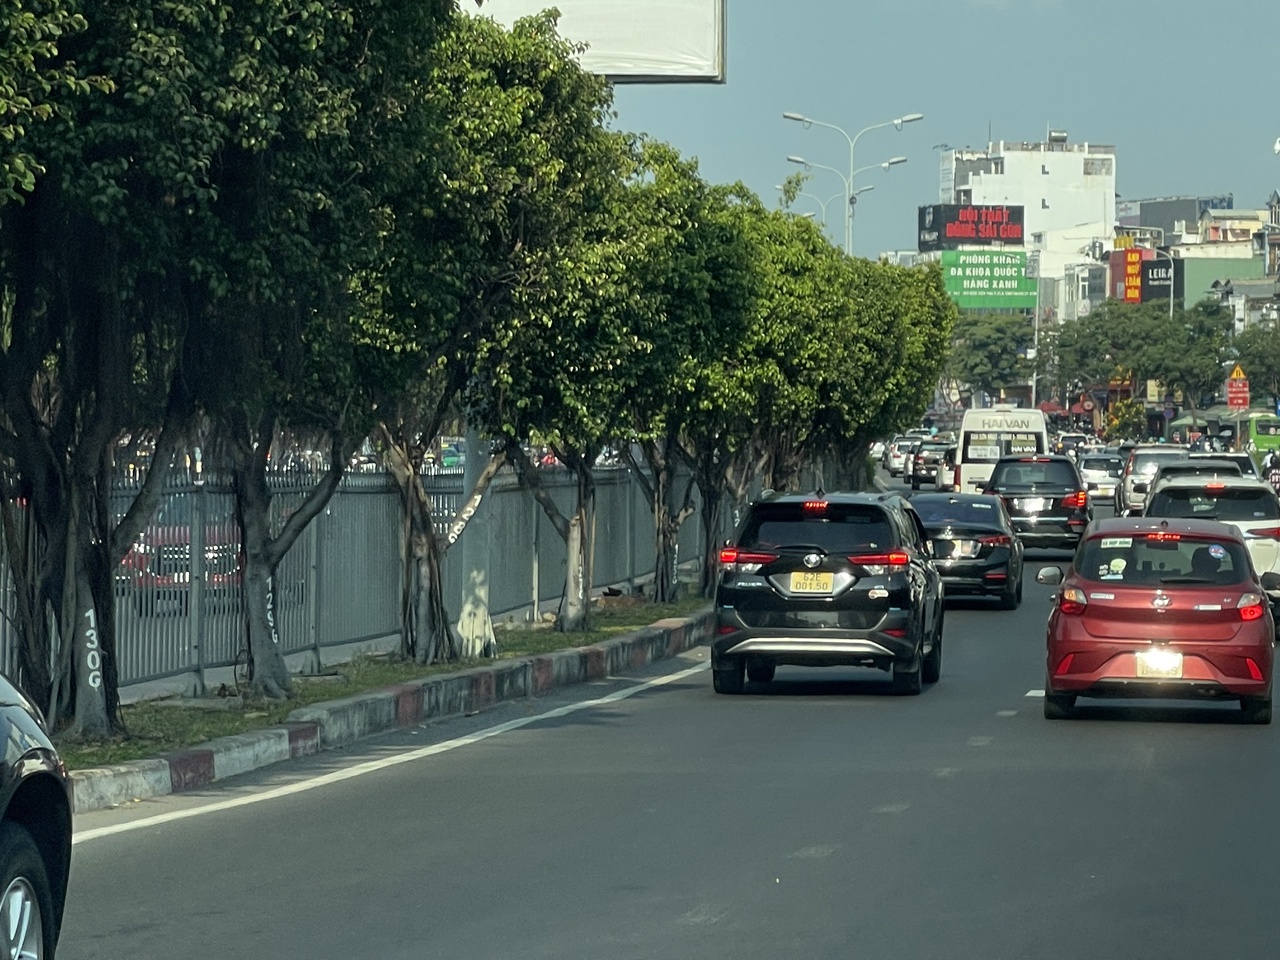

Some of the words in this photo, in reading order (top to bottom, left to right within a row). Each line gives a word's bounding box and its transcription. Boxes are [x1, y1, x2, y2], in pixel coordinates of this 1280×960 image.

[966, 267, 991, 277] KHOA
[992, 280, 1018, 289] XANH
[803, 573, 822, 582] 62E
[795, 582, 829, 591] 001.50
[85, 608, 101, 688] 130G
